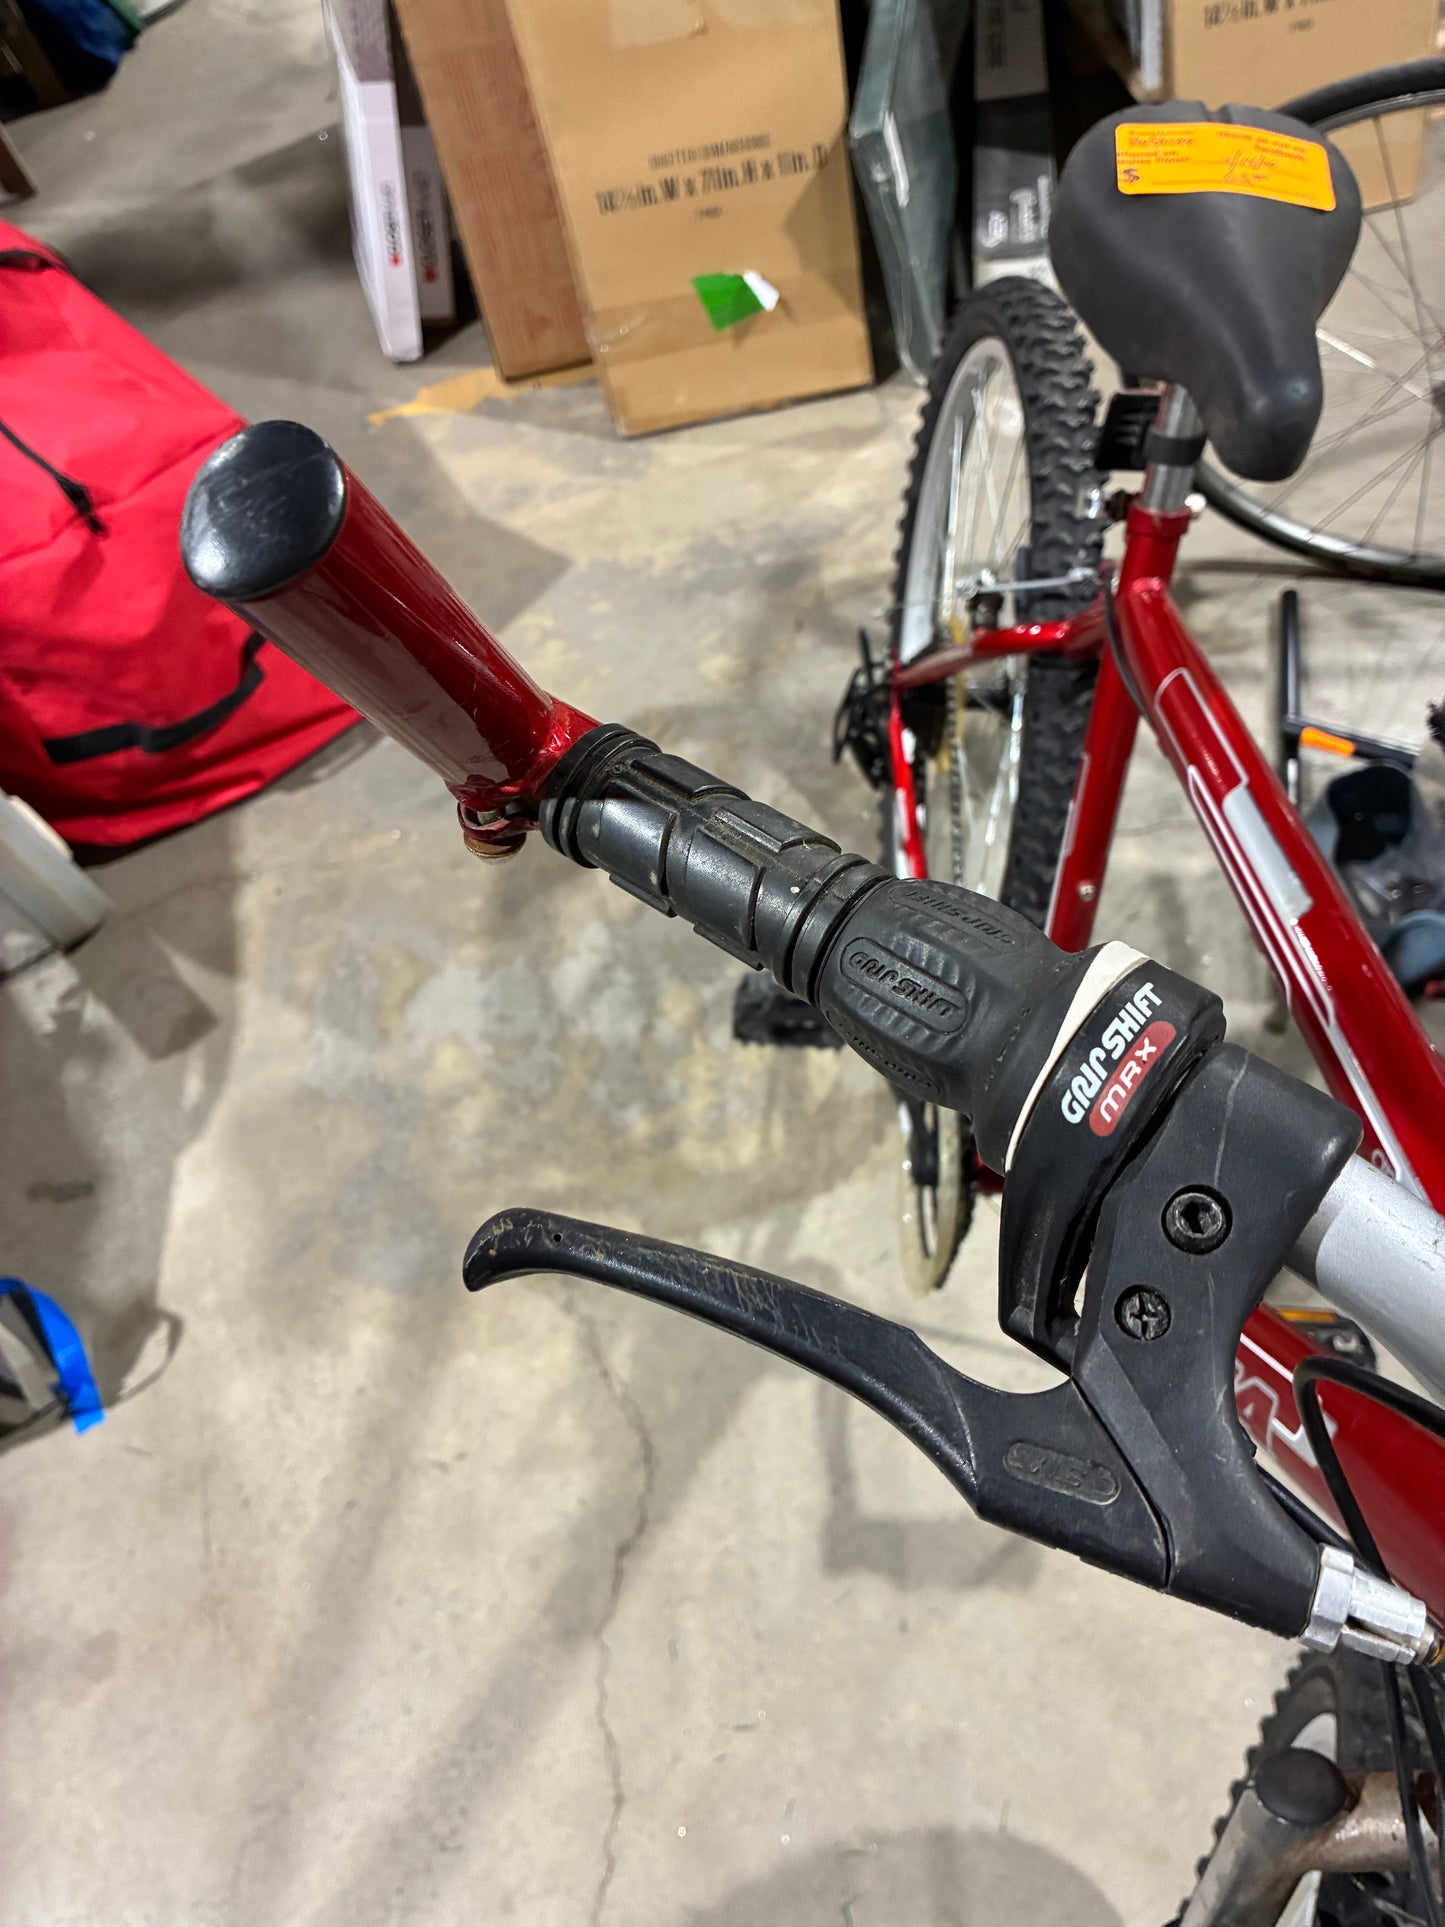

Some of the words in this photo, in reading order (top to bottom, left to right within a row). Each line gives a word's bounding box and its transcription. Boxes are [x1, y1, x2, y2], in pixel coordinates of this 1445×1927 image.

[848, 951, 900, 984] GRIP
[891, 977, 962, 1017] SHIFT
[1061, 1046, 1109, 1124] GRIP
[1101, 982, 1163, 1061] SHIFT
